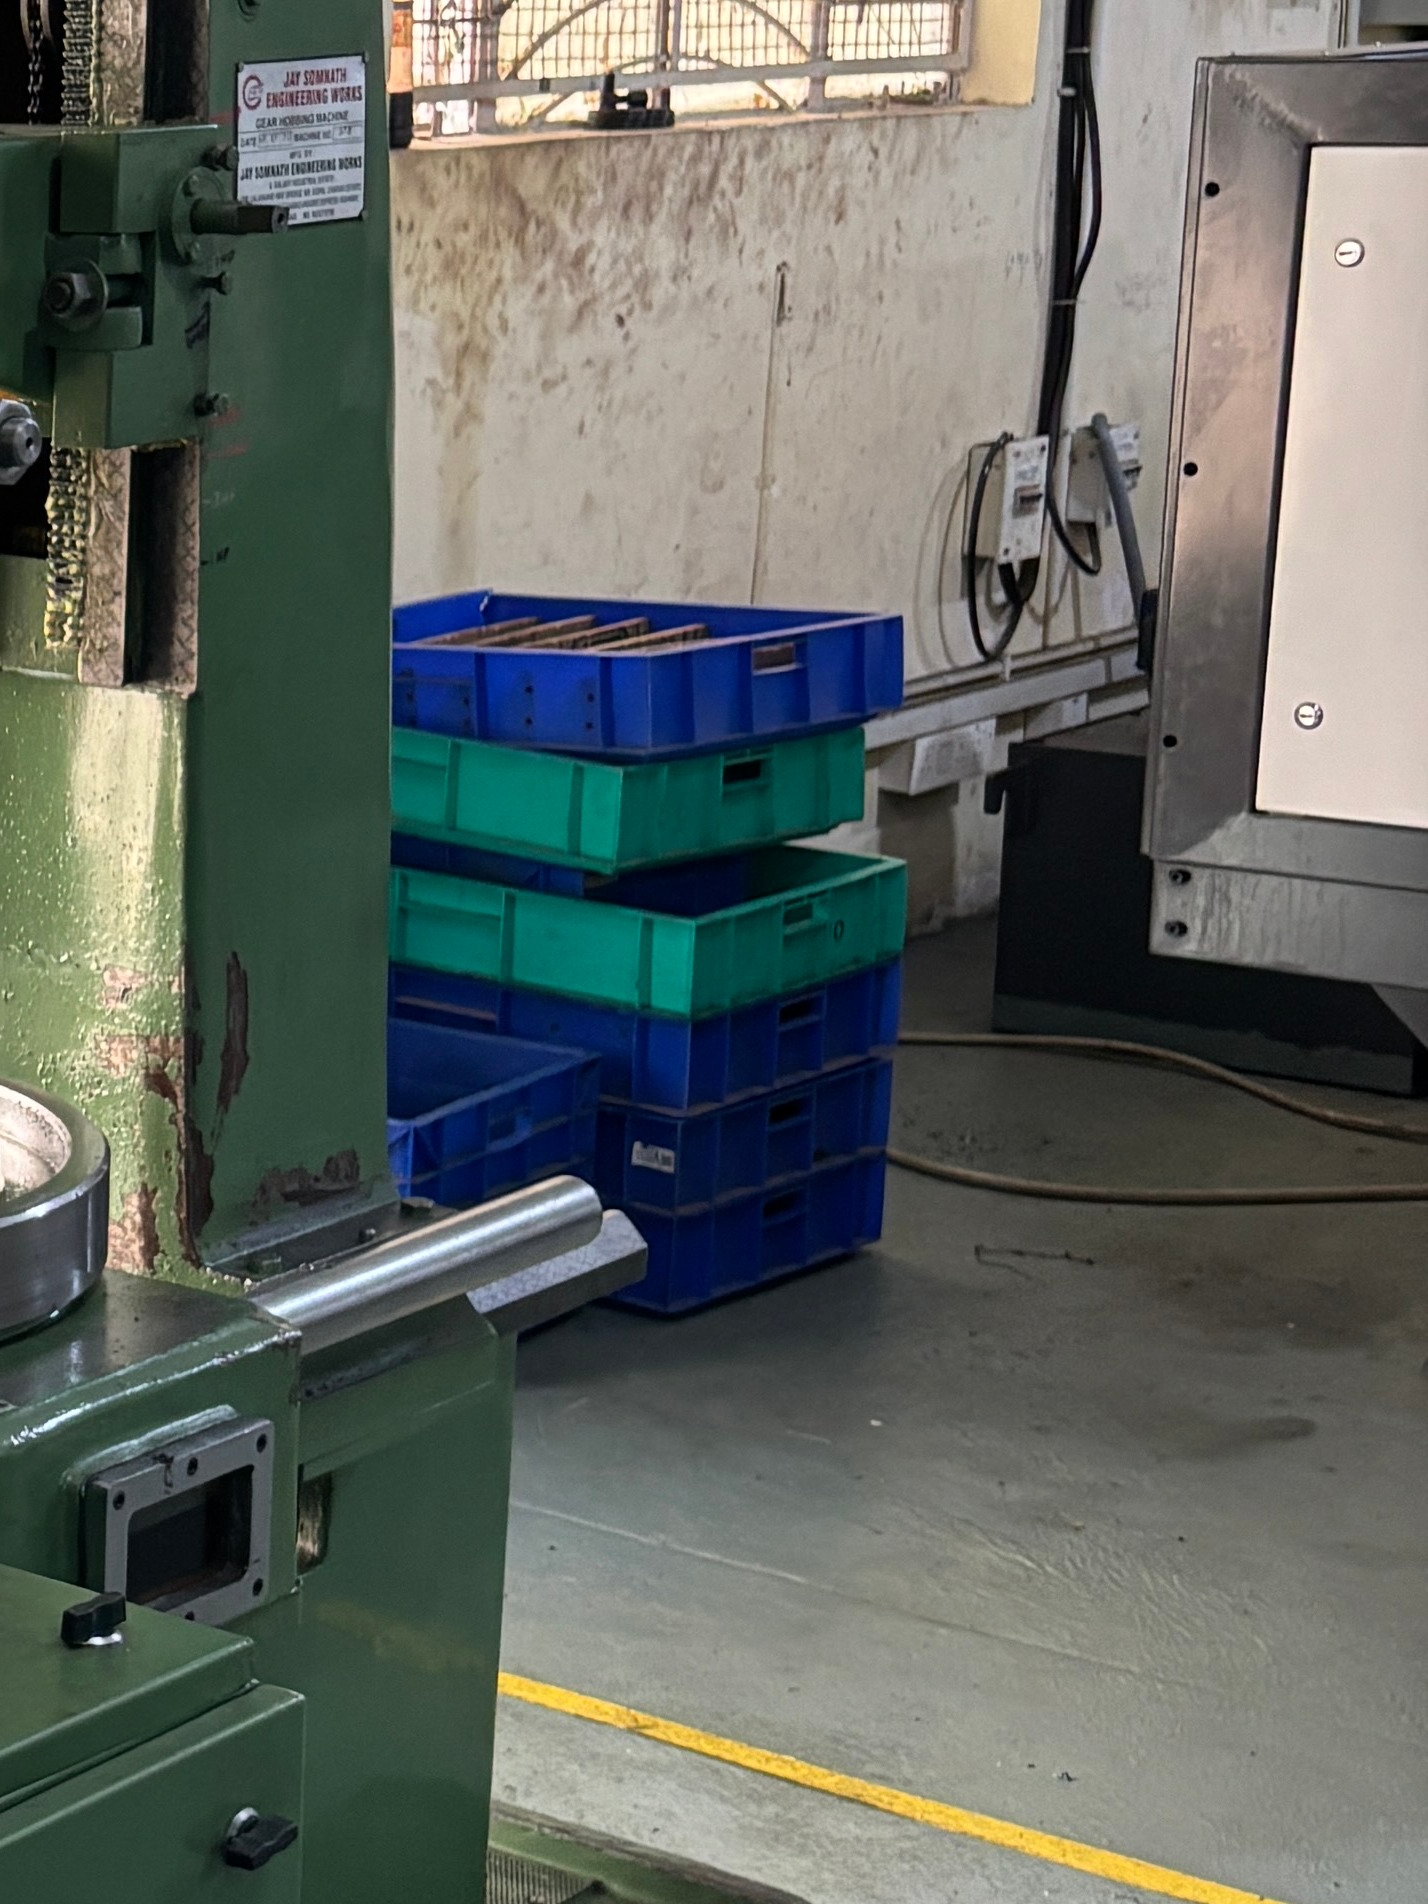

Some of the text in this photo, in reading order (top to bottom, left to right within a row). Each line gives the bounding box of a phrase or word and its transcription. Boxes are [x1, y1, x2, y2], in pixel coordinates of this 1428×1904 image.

[284, 67, 347, 88] JAY SOMNATH
[266, 89, 329, 108] ENGINEERING
[331, 85, 362, 103] WORKS
[256, 116, 277, 129] GEAR
